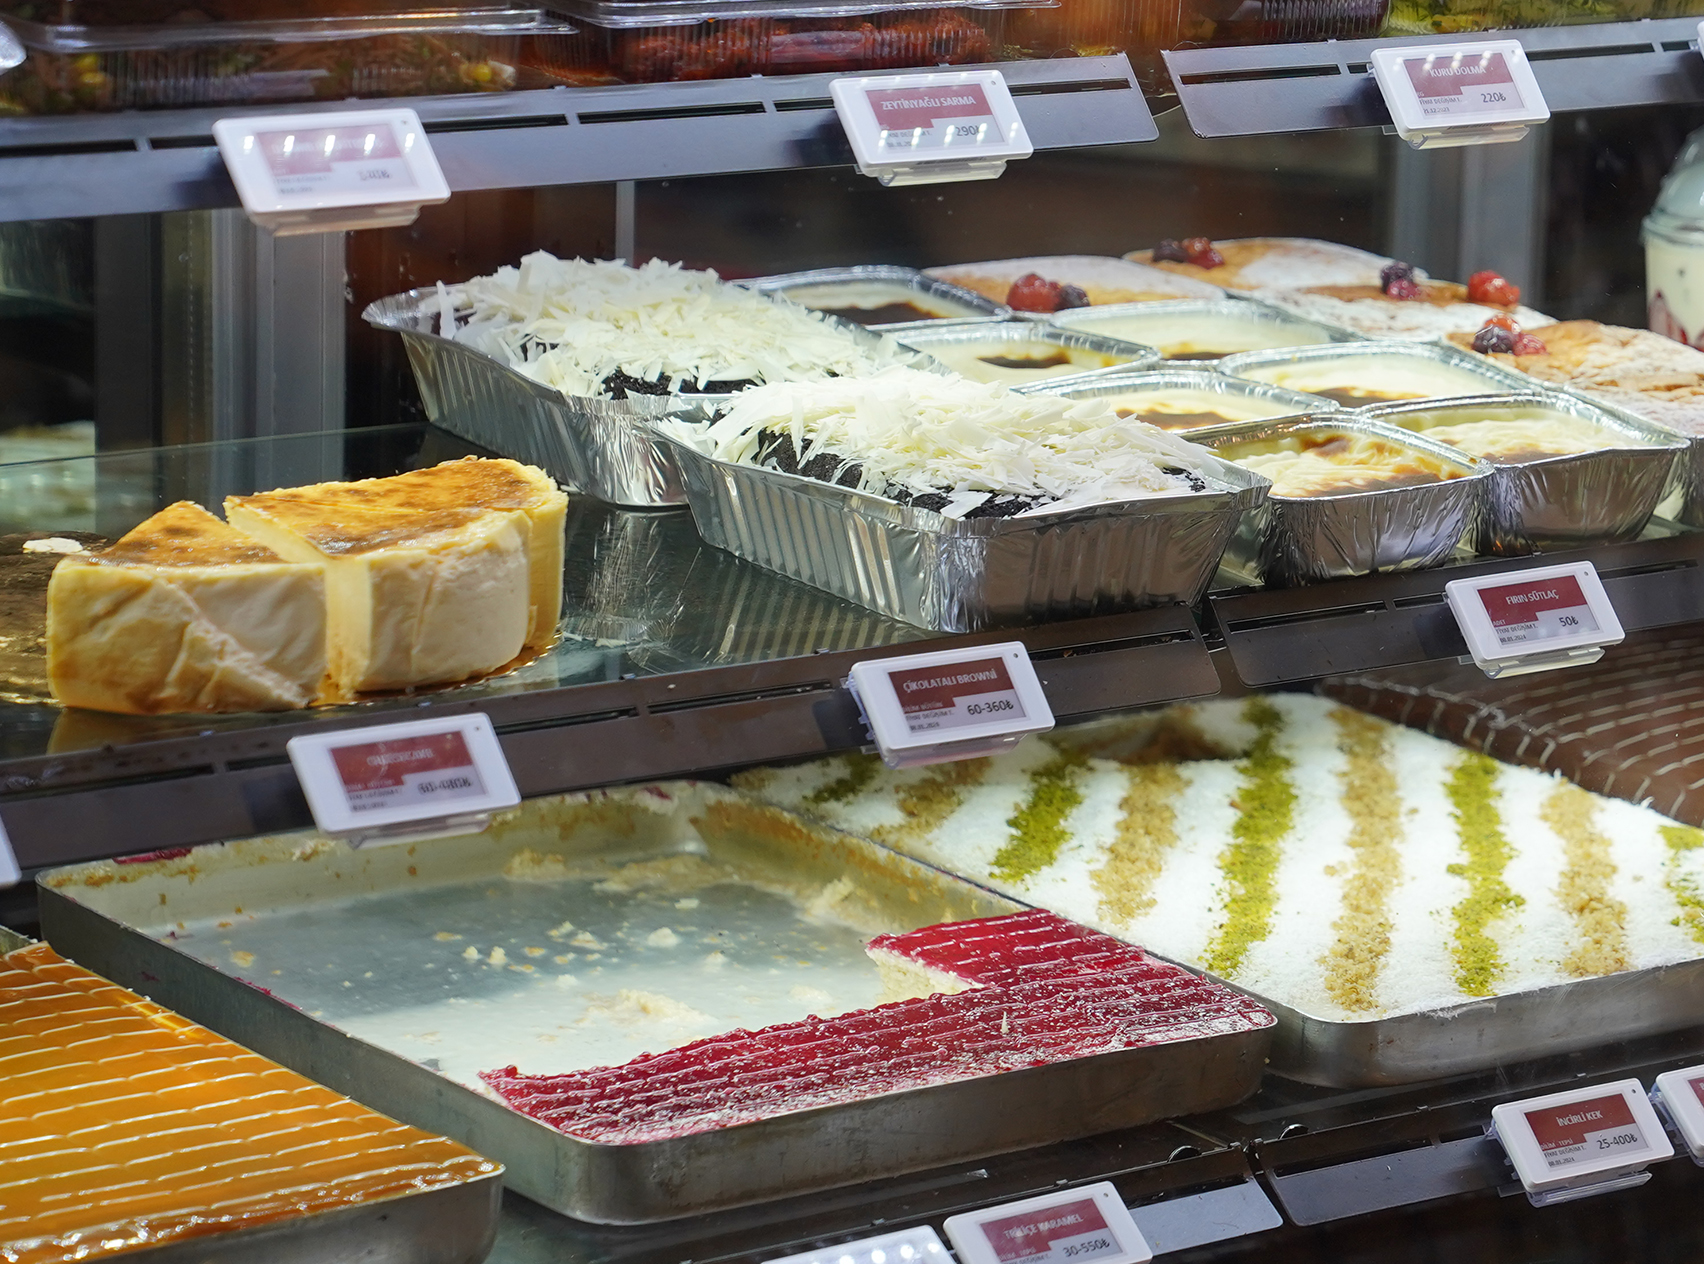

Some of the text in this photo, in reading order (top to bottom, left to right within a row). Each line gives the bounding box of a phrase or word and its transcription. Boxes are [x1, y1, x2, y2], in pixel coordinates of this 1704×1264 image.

[1430, 65, 1486, 77] KURU DOLMA
[880, 96, 976, 110] ZEYTİNYAĞLI SARMA
[1481, 92, 1506, 103] 220₺
[1506, 590, 1560, 605] FIRIN SÜTLAÇ
[1559, 616, 1579, 627] 50₺
[903, 668, 998, 693] ÇİKOLATALI BROWNİ
[967, 700, 1014, 715] 60-360₺
[1556, 1110, 1603, 1126] İNCİRLİ KEK
[1597, 1133, 1638, 1149] 25-400₺
[1038, 1214, 1084, 1231] KARAMEL
[1063, 1238, 1110, 1257] 30-550₺
